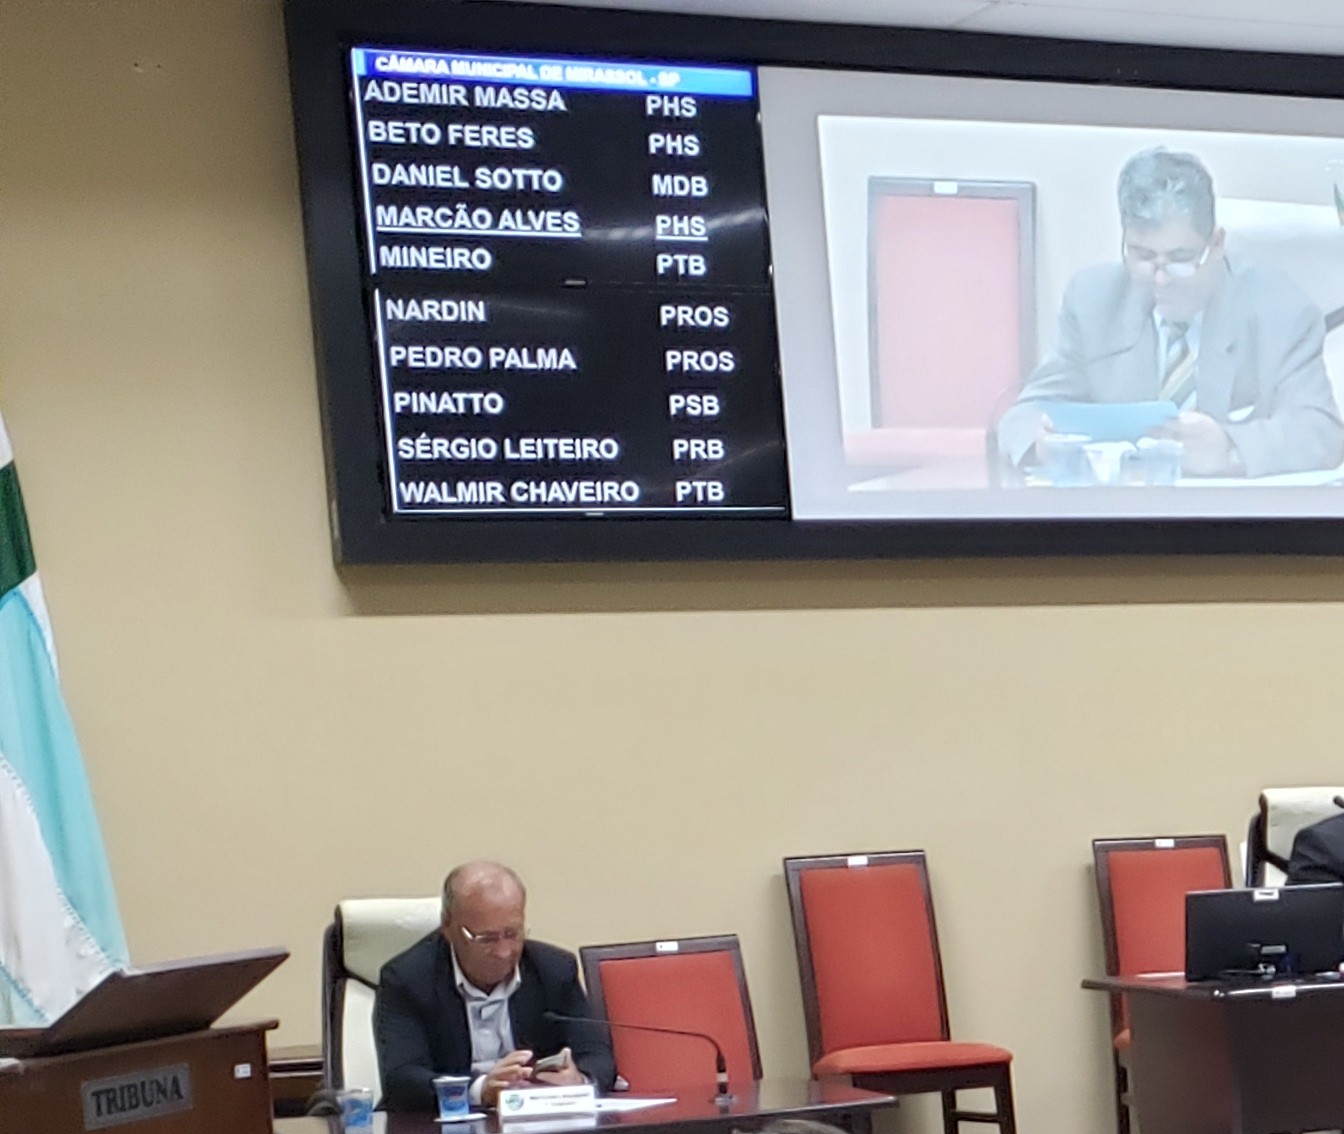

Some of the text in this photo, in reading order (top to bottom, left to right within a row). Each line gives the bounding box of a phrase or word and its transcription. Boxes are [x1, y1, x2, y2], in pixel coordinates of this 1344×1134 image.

[375, 55, 449, 74] CÂMARA
[451, 60, 537, 80] MUNICIPAL
[540, 66, 563, 81] DE
[364, 79, 568, 110] ADEMIR MASSA
[646, 95, 696, 117] PHS
[368, 120, 534, 148] BETO FERES
[649, 133, 699, 156] PHS
[372, 163, 563, 192] DANIEL SOTTO
[652, 174, 708, 196] MDB
[376, 204, 581, 232] MARCÃO ALVES
[655, 215, 708, 236] PHS
[380, 246, 492, 270] MINEIRO
[657, 254, 706, 276] PTB
[386, 299, 486, 321] NARDIN
[661, 305, 729, 327] PROS
[390, 346, 577, 369] PEDRO PALMA
[666, 350, 735, 371] PROS
[394, 392, 504, 414] PINATTO
[670, 395, 720, 415] PSB
[398, 433, 619, 459] SÉRGIO LEITEIRO
[673, 439, 725, 459] PRB
[397, 481, 640, 503] WALMIR CHAVEIRO
[676, 481, 724, 501] PTB
[91, 1075, 183, 1117] TRIBUNA
